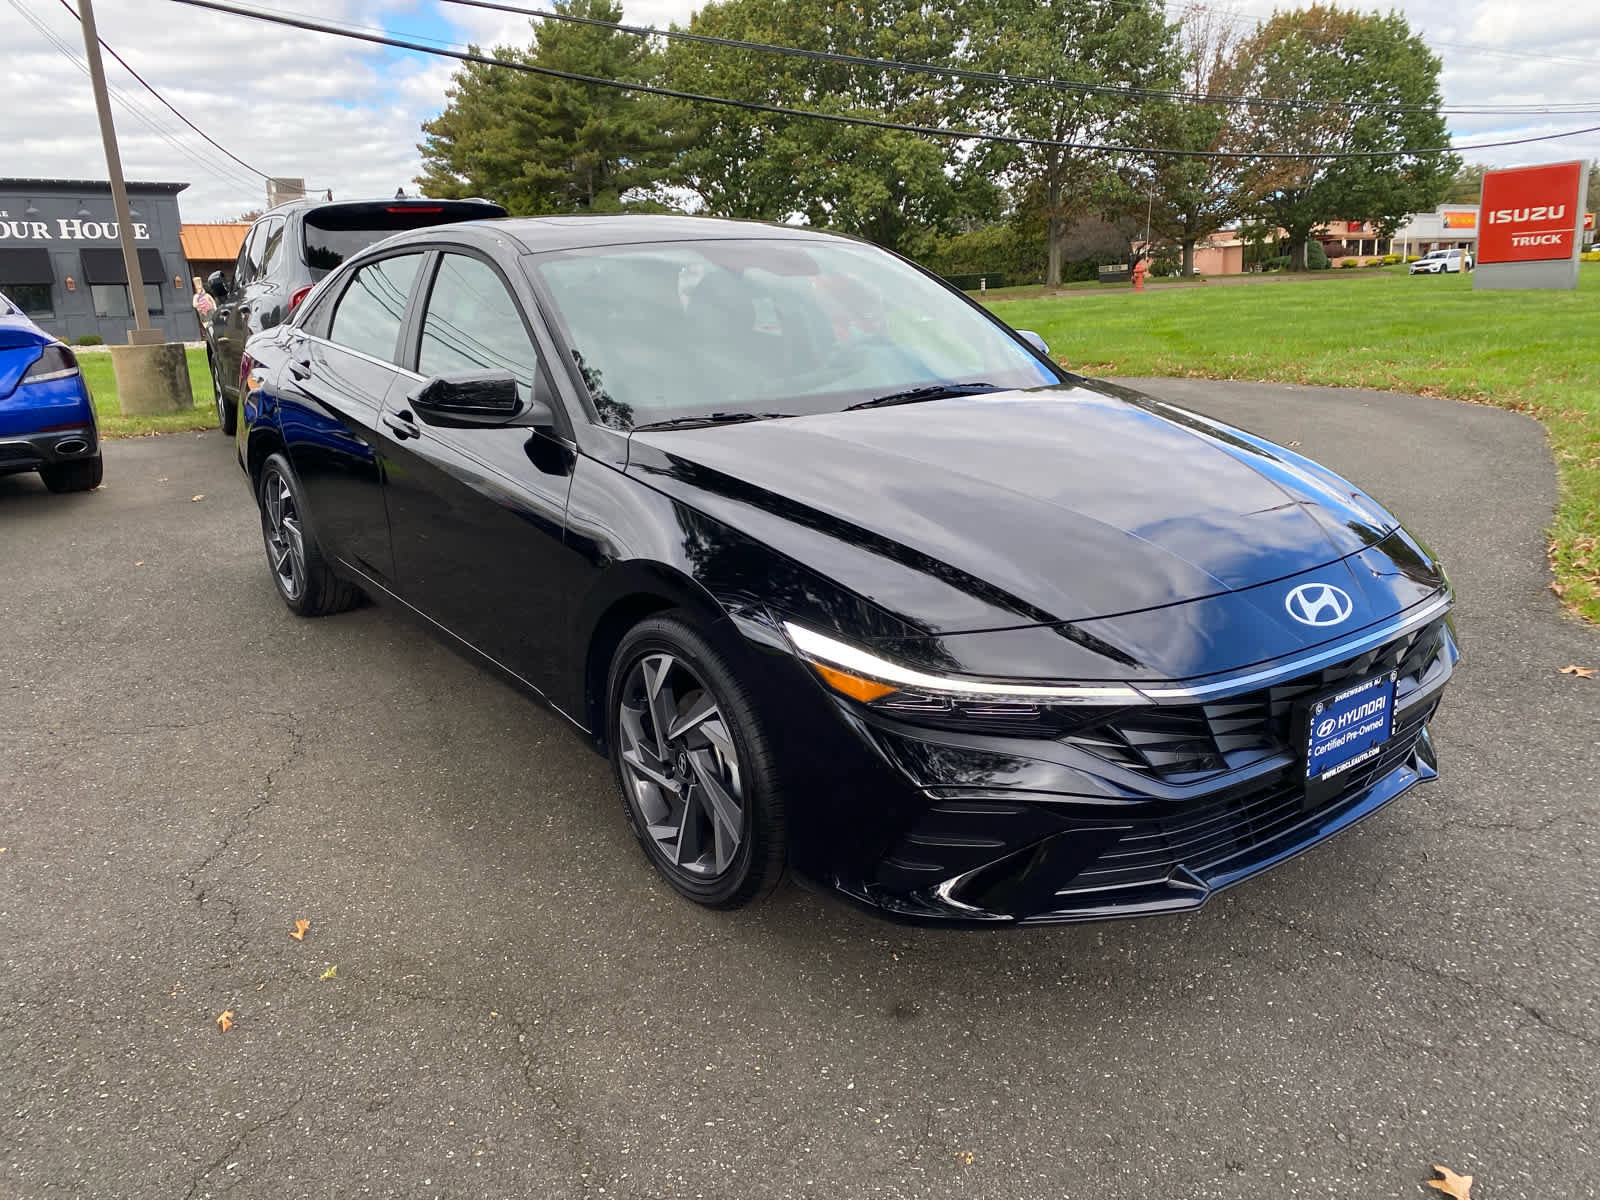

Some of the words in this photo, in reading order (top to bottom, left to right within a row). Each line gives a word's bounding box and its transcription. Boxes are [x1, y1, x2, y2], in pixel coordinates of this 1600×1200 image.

[1488, 205, 1566, 224] ISUZU
[56, 218, 150, 240] HOUE
[1511, 233, 1562, 247] TRUCK
[1337, 695, 1387, 729] HYUNDAI
[1314, 732, 1346, 757] Certified
[1346, 716, 1384, 743] Pre-Owned
